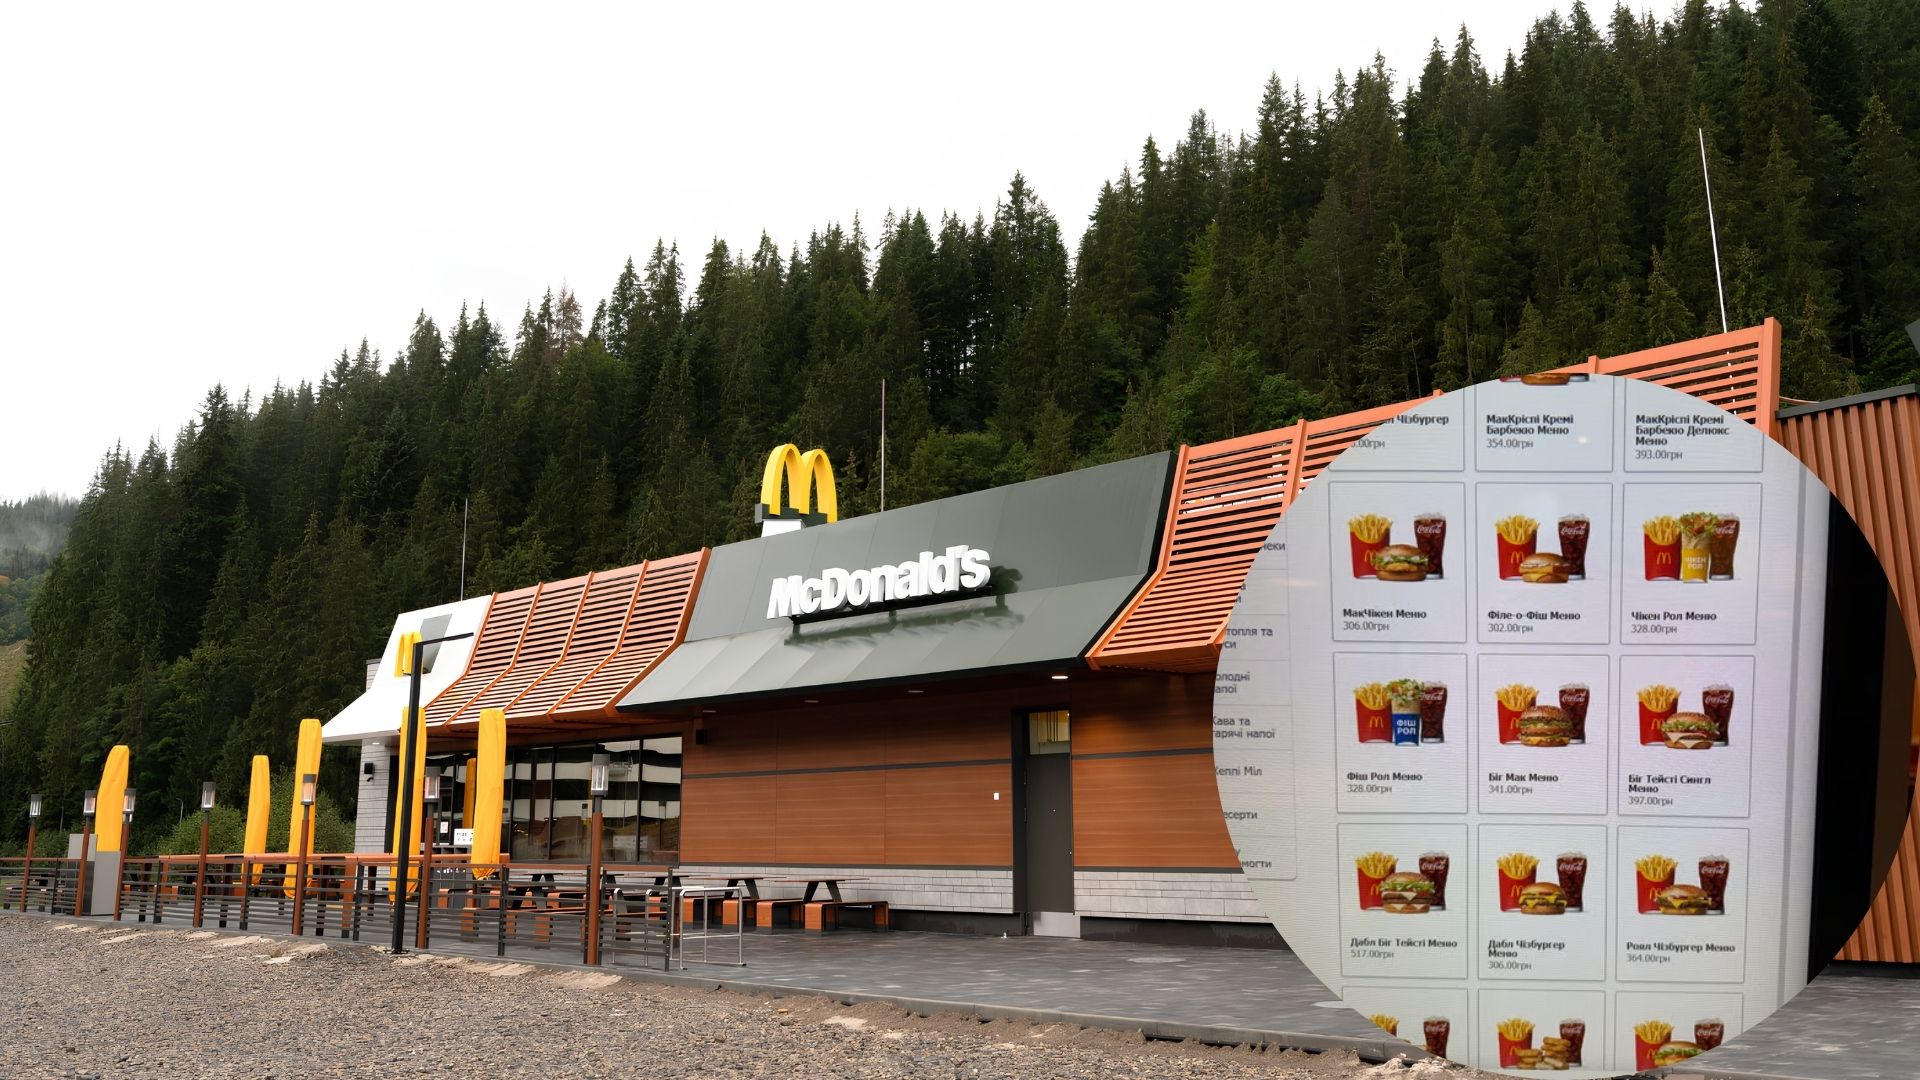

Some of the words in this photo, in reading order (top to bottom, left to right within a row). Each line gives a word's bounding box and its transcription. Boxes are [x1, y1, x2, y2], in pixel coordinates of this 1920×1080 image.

[1486, 414, 1540, 426] МакКріспі
[1543, 414, 1574, 426] Кремі
[1636, 414, 1690, 426] МакКріспі
[1693, 414, 1724, 426] Кремі
[1486, 425, 1534, 436] Барбекю
[1538, 426, 1569, 434] Меню
[1636, 426, 1684, 436] Барбекю
[1687, 426, 1730, 436] Делюкс
[1486, 438, 1534, 450] 354.00грн
[1636, 437, 1668, 446] Меню
[1635, 450, 1682, 460] 393.00грн
[766, 544, 991, 620] McDonald's
[1343, 608, 1393, 618] МакЧікен
[1396, 609, 1426, 618] Меню
[1488, 610, 1548, 620] Філе-о-Фіш
[1550, 611, 1580, 620] Меню
[1631, 611, 1660, 620] Чікен
[1663, 612, 1682, 620] Рол
[1686, 612, 1717, 620] Меню
[1344, 621, 1390, 632] 306.00грн
[1488, 623, 1534, 634] 302.00грн
[1632, 624, 1678, 634] 328.00грн
[1247, 729, 1276, 738] напої
[1244, 766, 1262, 776] Міл
[1347, 772, 1368, 780] Фіш
[1370, 772, 1390, 780] Рол
[1392, 772, 1422, 781] Меню
[1488, 773, 1502, 782] Біг
[1506, 774, 1526, 782] Мак
[1529, 774, 1558, 782] Меню
[1628, 774, 1642, 783] Біг
[1646, 774, 1678, 784] Тейсті
[1680, 775, 1712, 784] Сингл
[1347, 784, 1392, 794] 328.00грн
[1488, 785, 1532, 796] 341.00грн
[1628, 784, 1659, 793] Меню
[1628, 796, 1672, 806] 397.00грн
[1350, 938, 1376, 948] Дабл
[1378, 938, 1392, 947] Біг
[1395, 938, 1426, 948] Тейсті
[1428, 939, 1458, 948] Меню
[1488, 940, 1514, 950] Дабл
[1516, 940, 1565, 950] Чізбургер
[1626, 942, 1652, 951] Роял
[1654, 942, 1703, 952] Чізбургер
[1706, 943, 1736, 952] Меню
[1488, 950, 1518, 958] Меню
